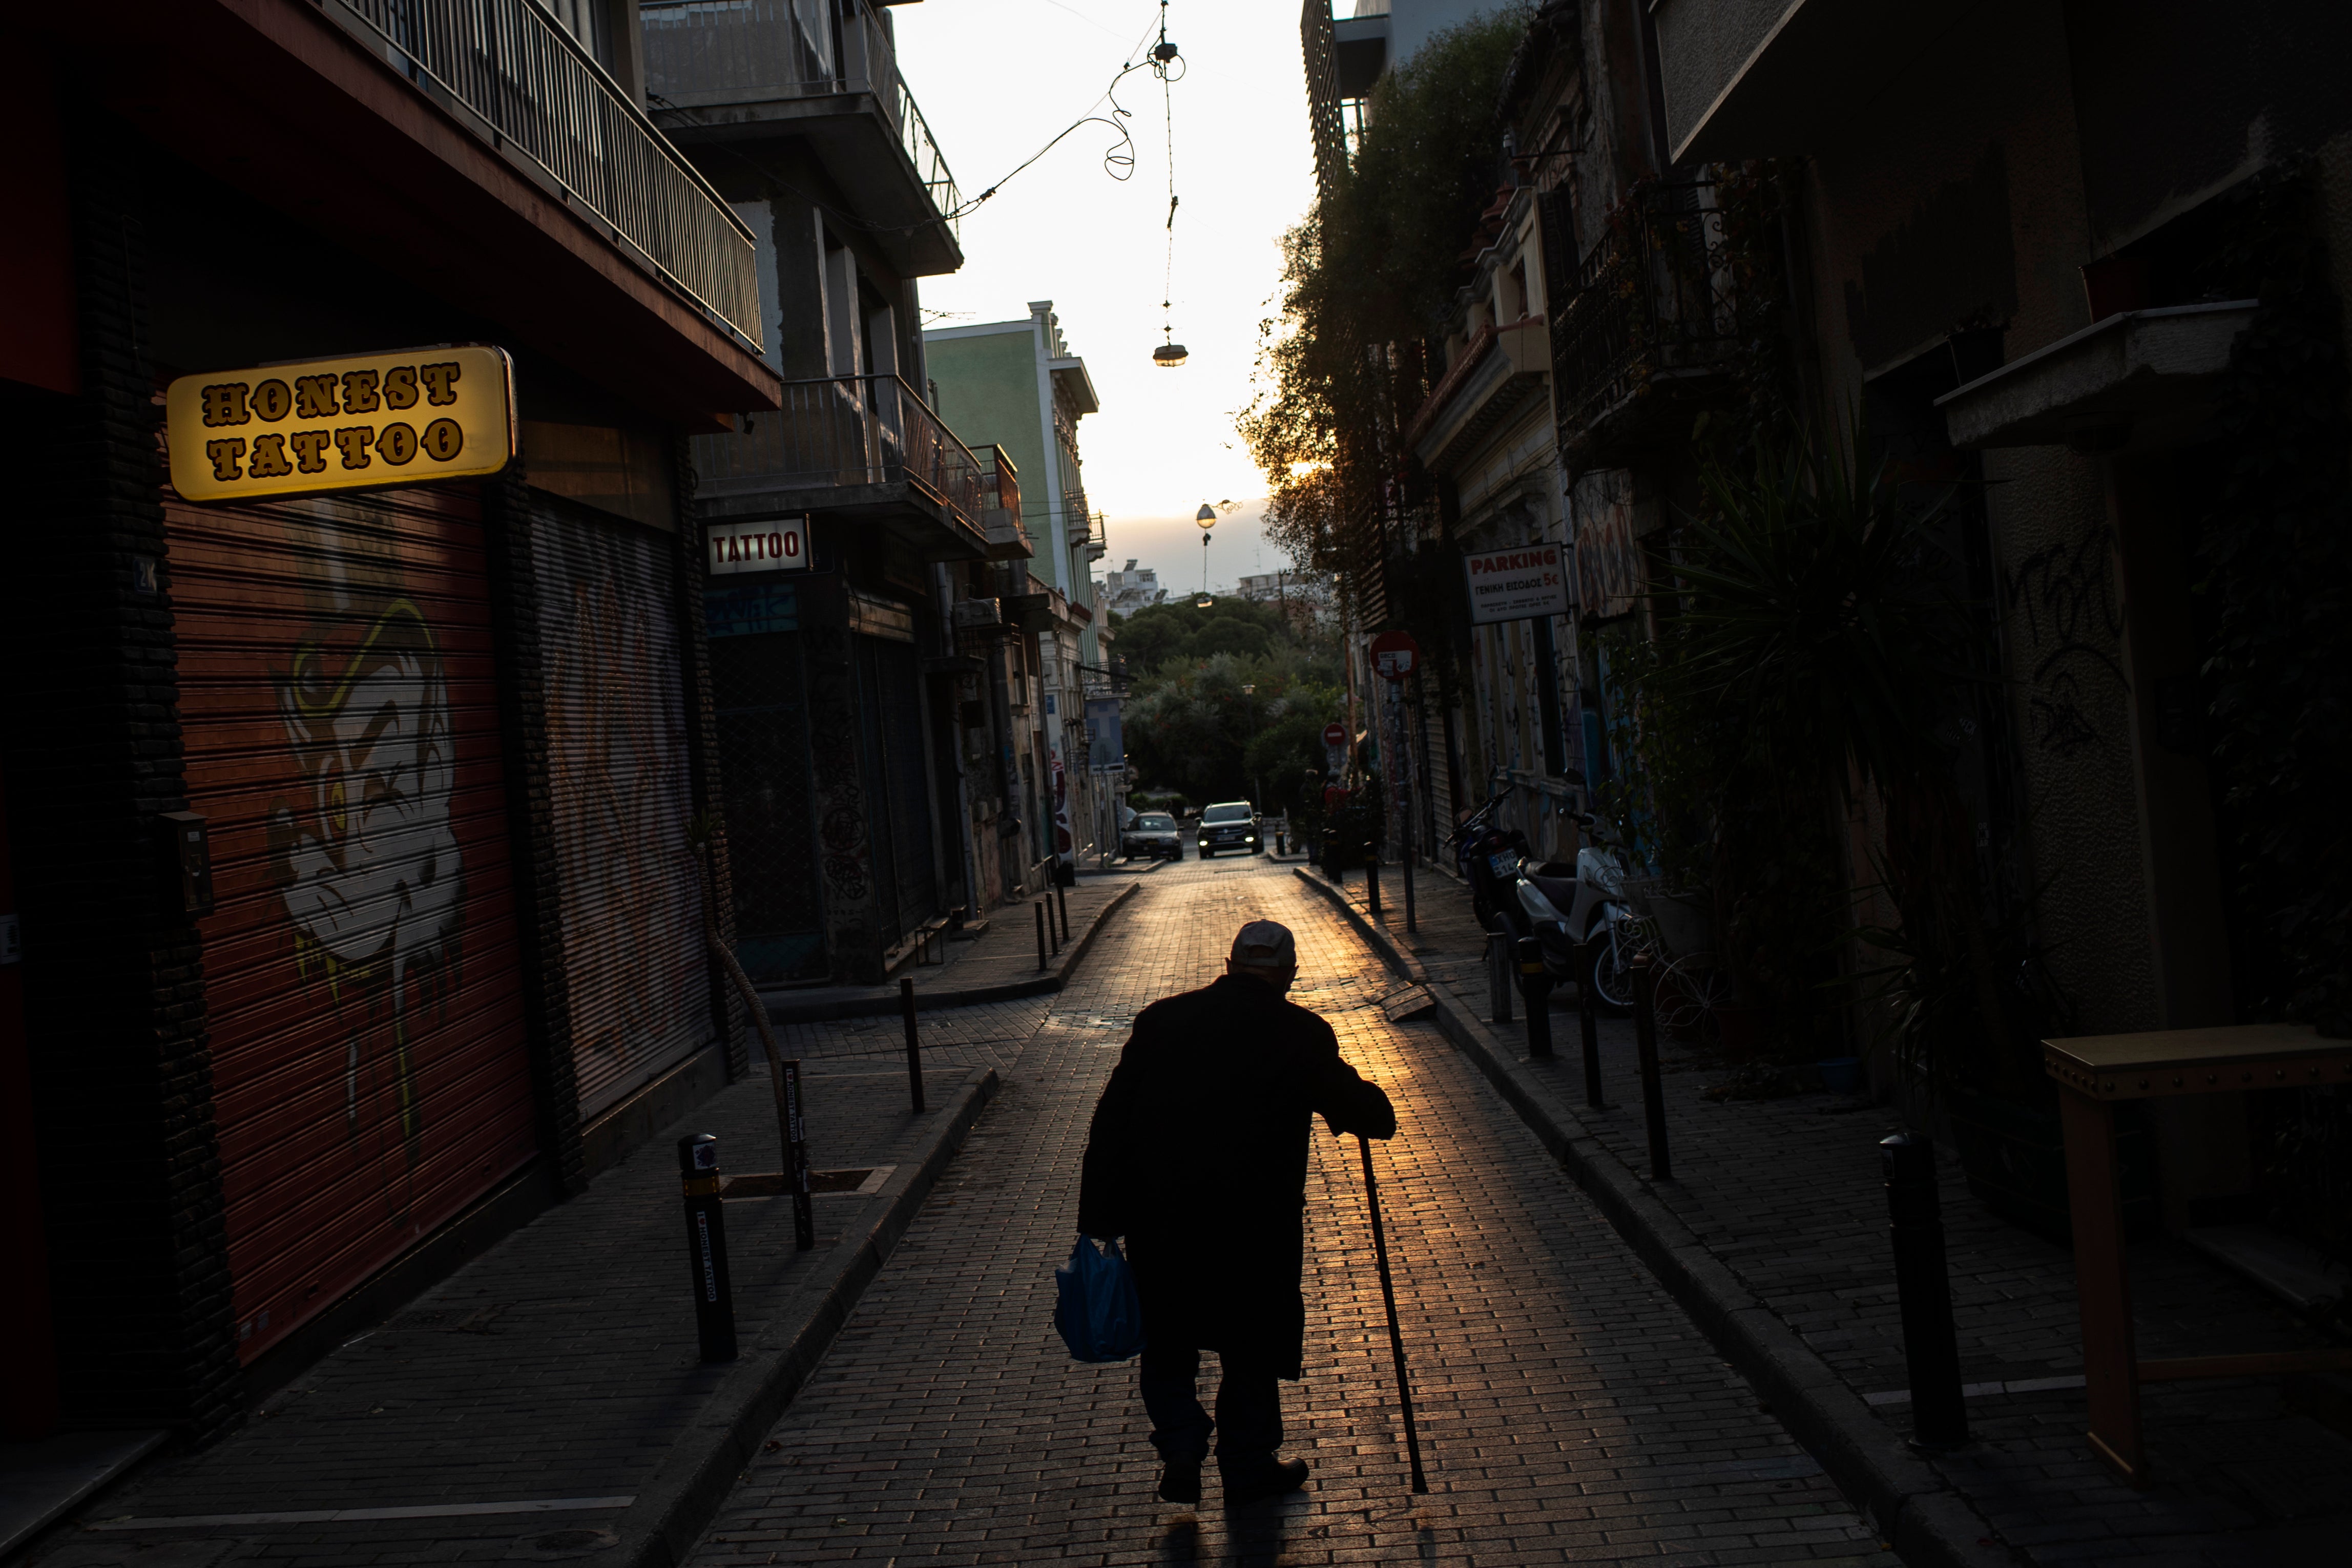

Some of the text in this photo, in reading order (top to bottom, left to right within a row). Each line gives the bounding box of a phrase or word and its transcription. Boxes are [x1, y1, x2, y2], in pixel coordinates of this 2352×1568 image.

[202, 362, 461, 427] HONEST
[206, 418, 463, 481] TATTOO
[713, 531, 799, 562] TATTOO
[1471, 549, 1556, 575] PARKING
[1475, 572, 1559, 595] ΓΕΝΙΚΗ ΕΙΣΟΔΟΣ 5€
[700, 1227, 710, 1263] HONEST
[705, 1265, 715, 1300] TATTOO
